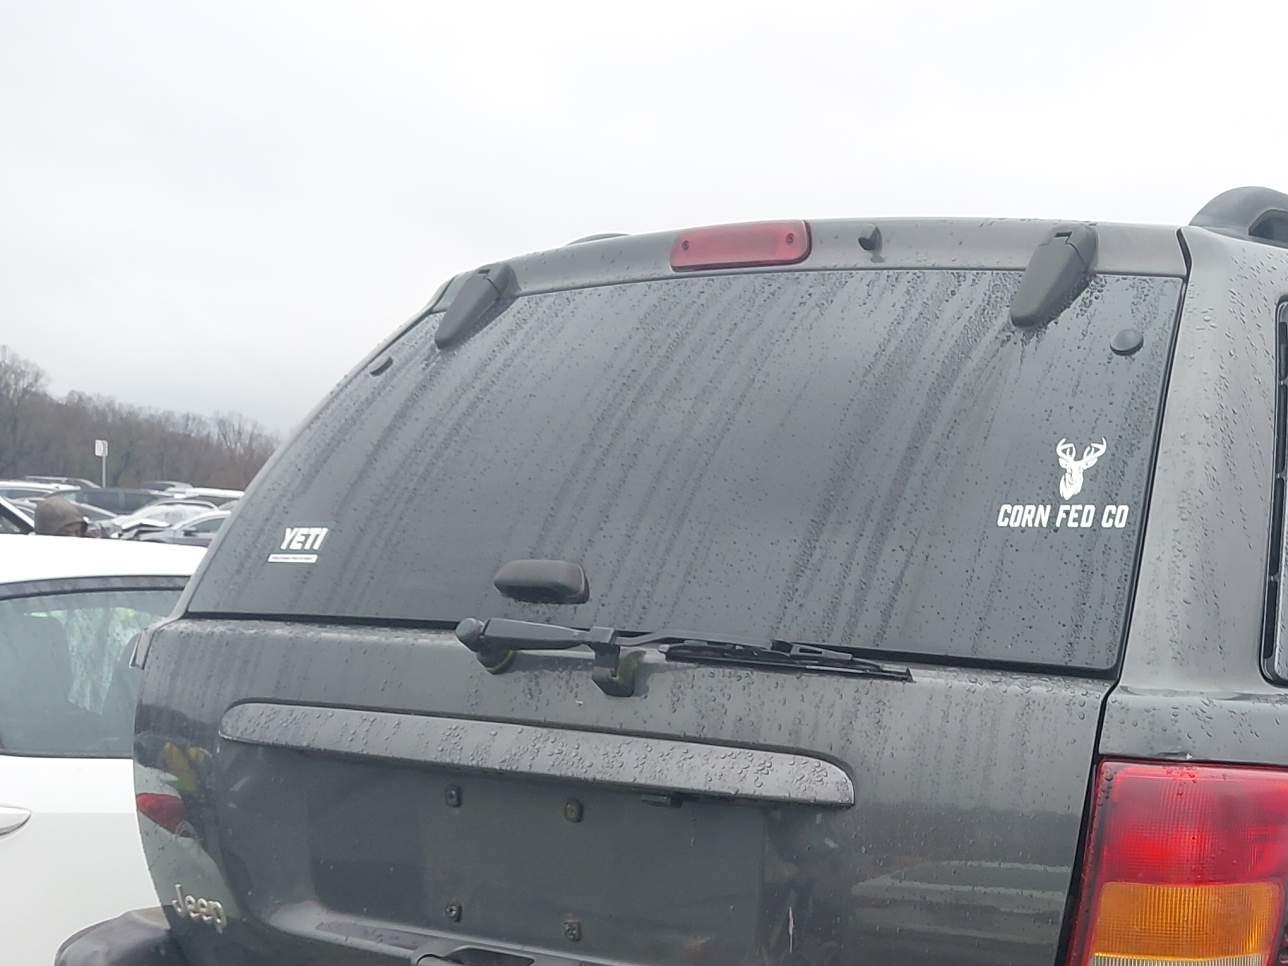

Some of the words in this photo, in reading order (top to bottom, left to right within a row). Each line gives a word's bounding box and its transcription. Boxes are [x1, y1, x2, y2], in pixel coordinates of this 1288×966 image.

[997, 504, 1050, 528] CORN
[1055, 504, 1096, 528] FED
[1101, 504, 1129, 528] CO
[280, 527, 329, 550] YETI
[172, 884, 228, 935] Jeep
